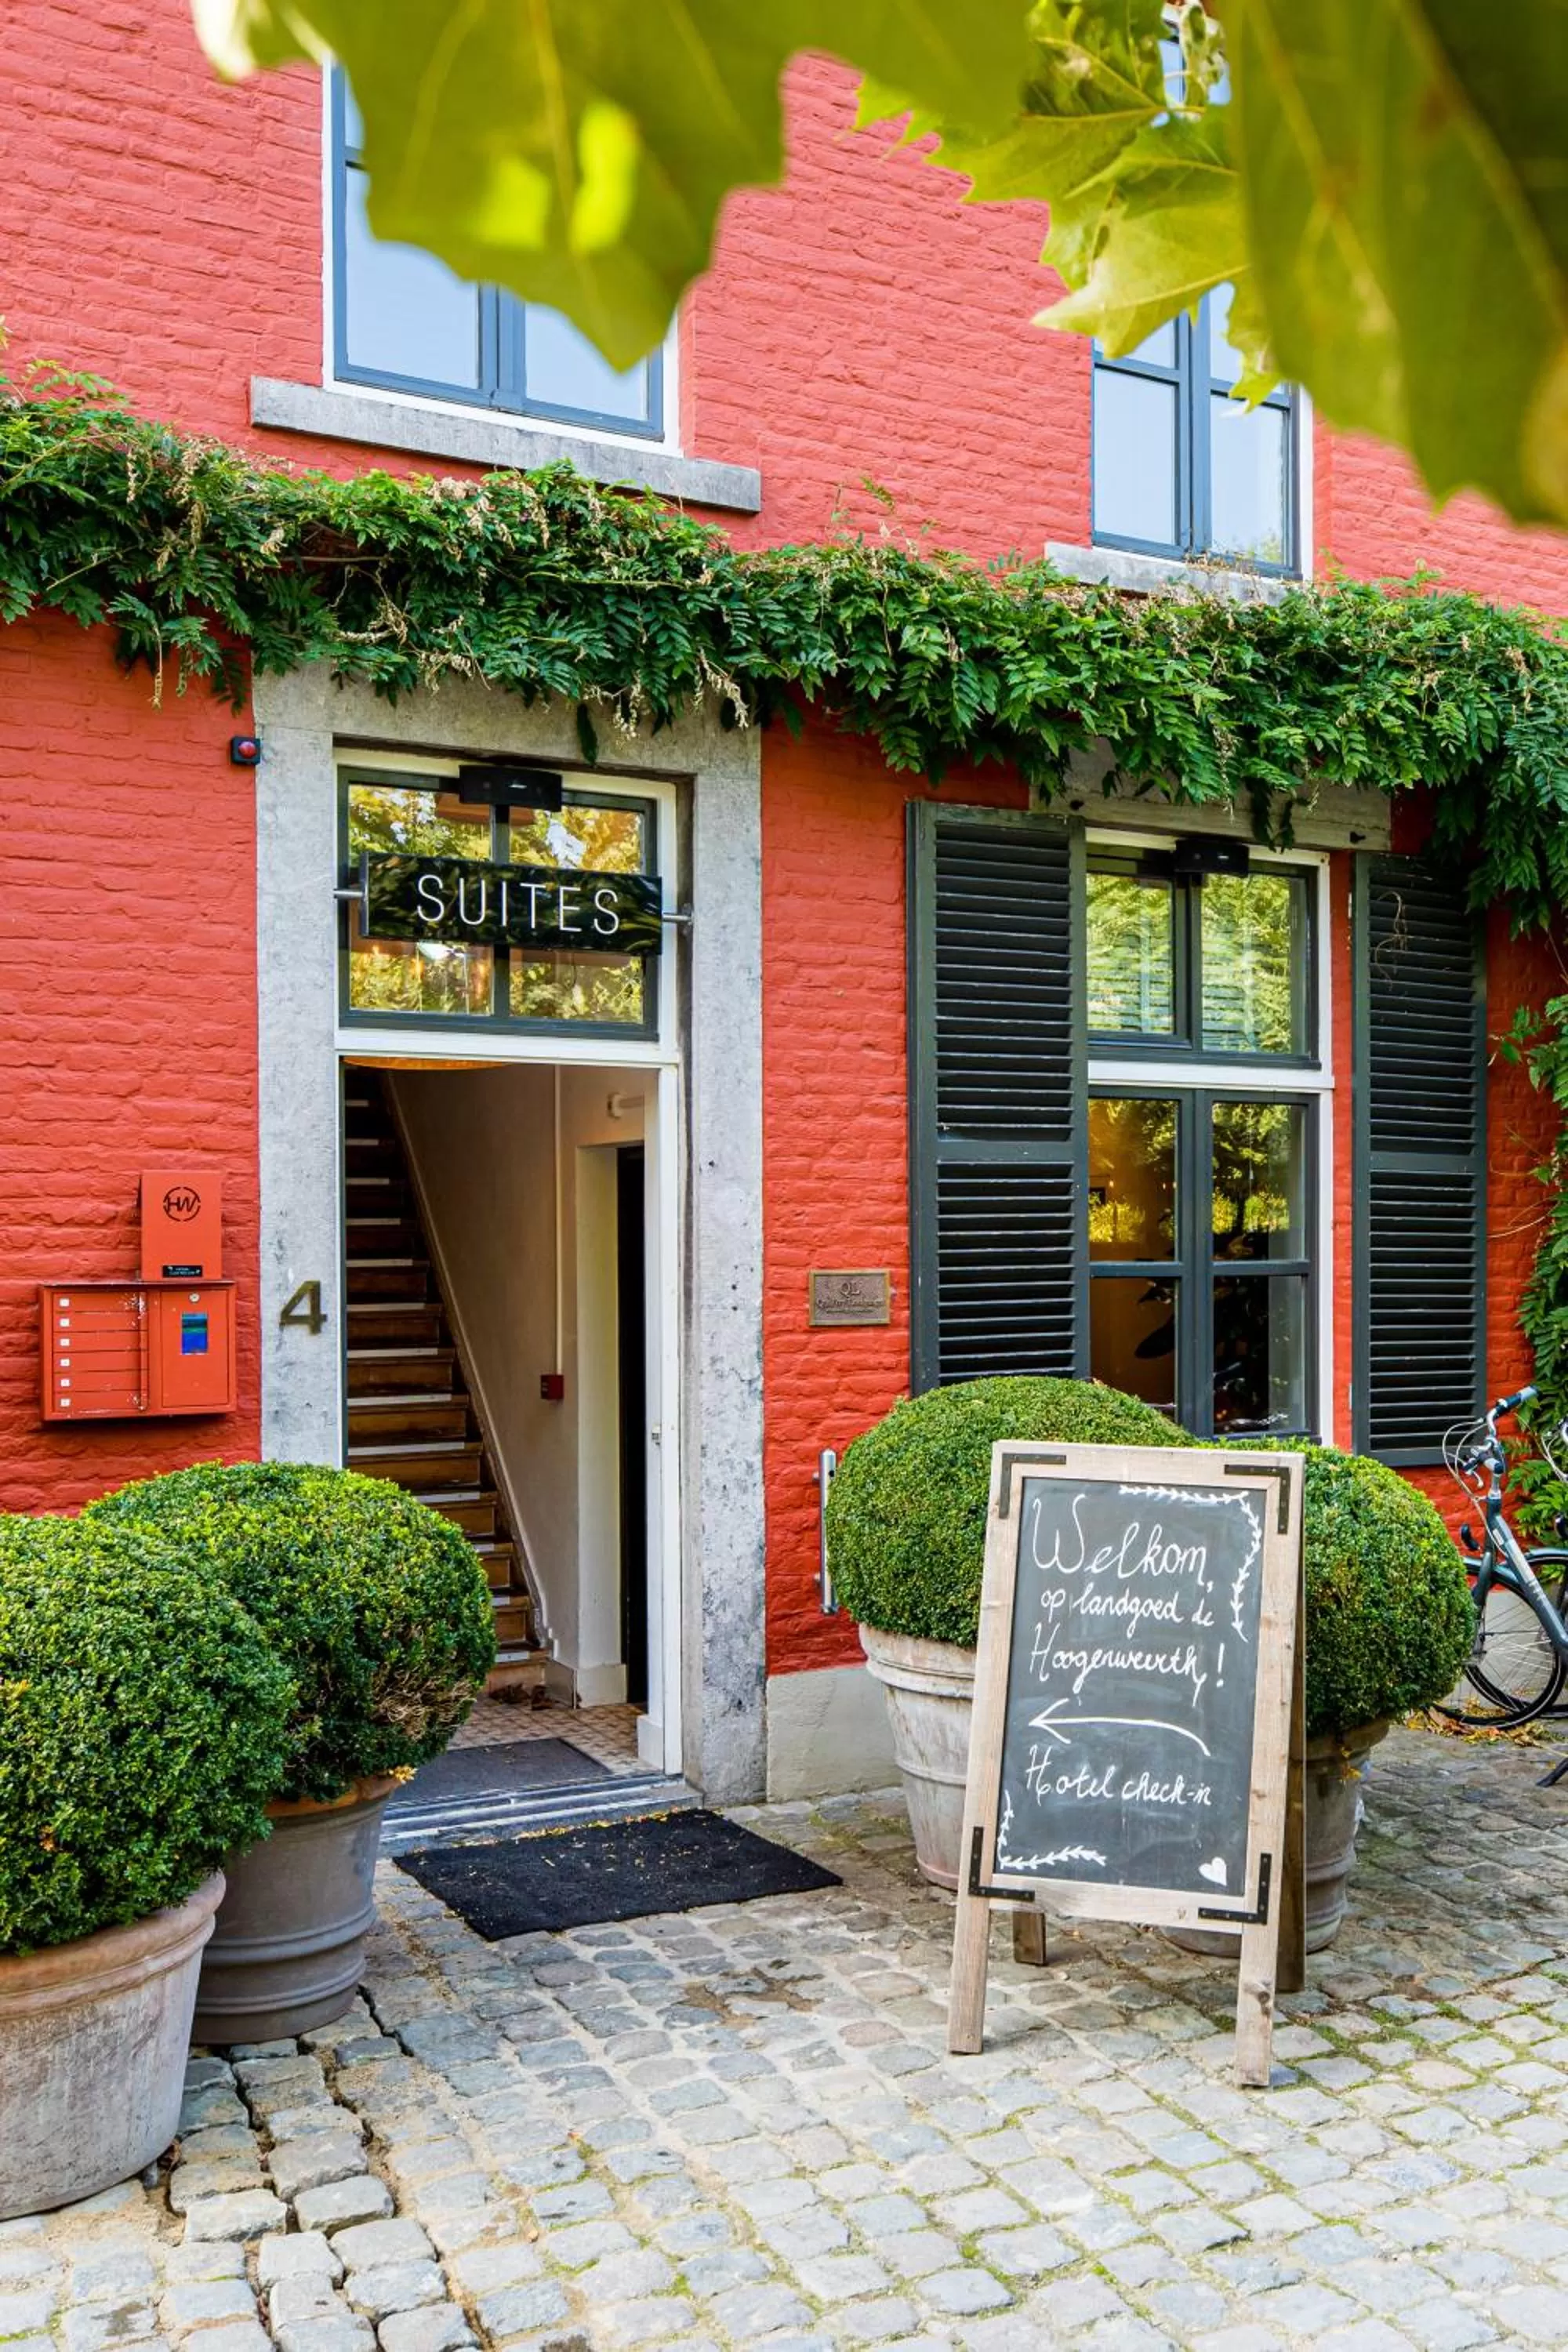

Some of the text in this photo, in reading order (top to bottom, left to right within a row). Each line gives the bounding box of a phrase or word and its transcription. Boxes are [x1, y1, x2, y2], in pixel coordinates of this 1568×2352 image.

[416, 873, 620, 935] SUITES
[165, 1192, 198, 1214] HW
[279, 1279, 328, 1335] 4
[1040, 1581, 1215, 1639] op landgoed de
[1025, 1743, 1213, 1807] Hotel check-in
